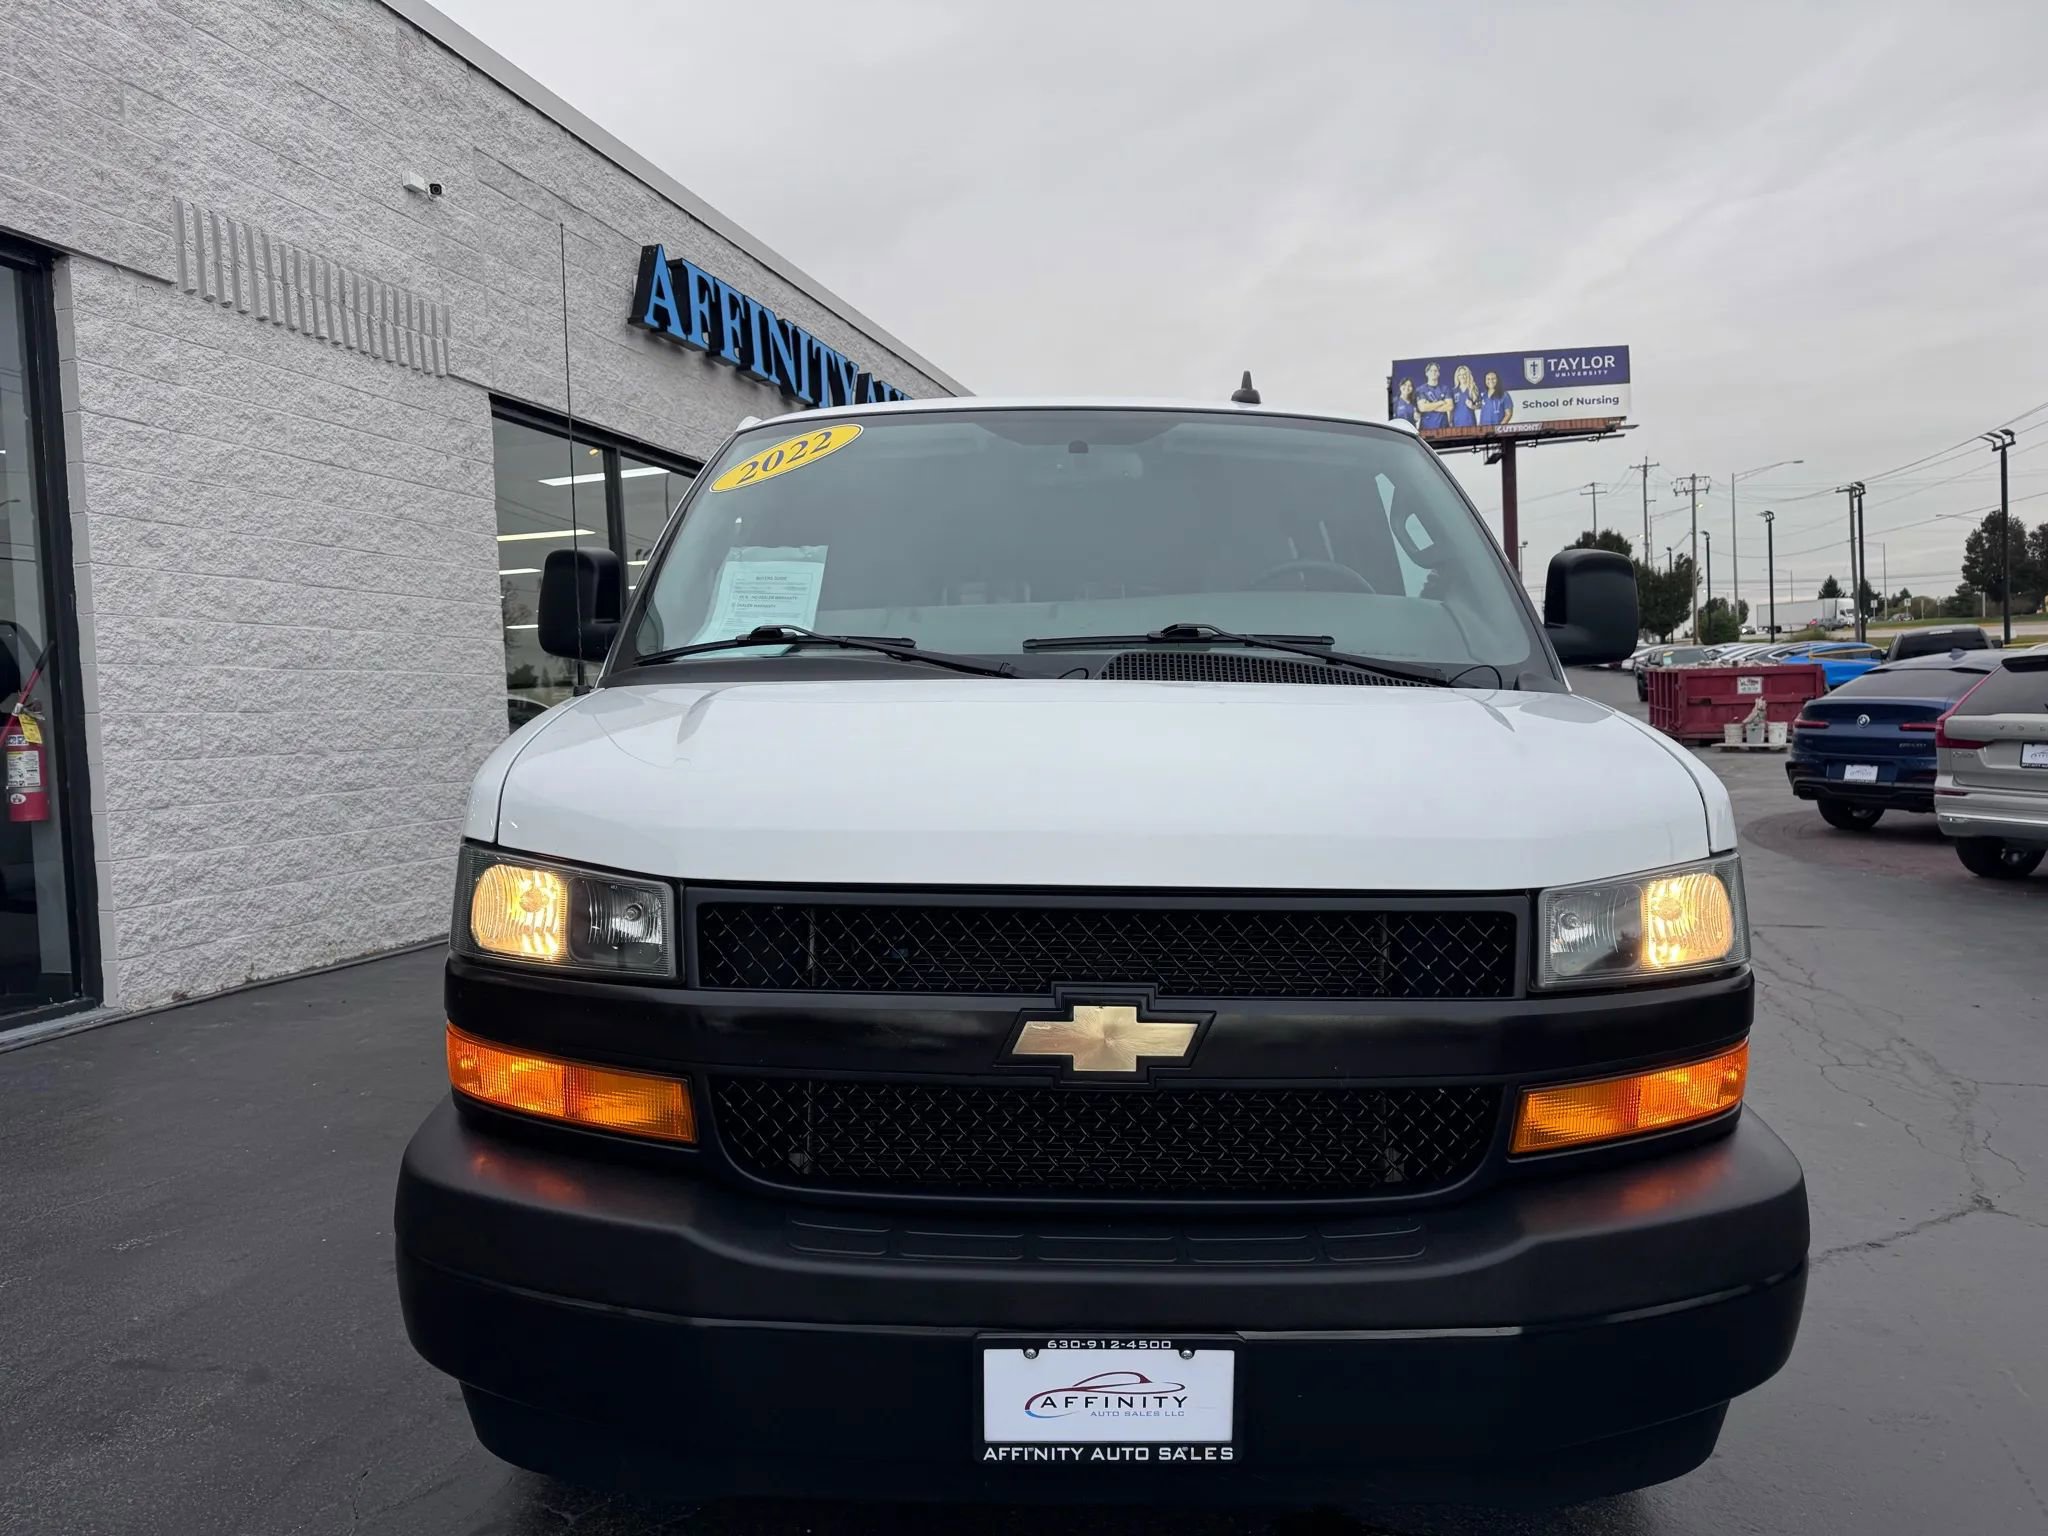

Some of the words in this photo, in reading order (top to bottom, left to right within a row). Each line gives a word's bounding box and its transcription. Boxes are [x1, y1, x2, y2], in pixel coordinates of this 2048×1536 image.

[642, 243, 860, 409] AFFINITY
[1547, 355, 1615, 371] TAYLOR
[1522, 398, 1559, 409] School
[1562, 397, 1573, 407] of
[1576, 395, 1620, 406] Nursing
[735, 431, 832, 486] 2022
[1047, 1340, 1172, 1349] 630-912-4500
[1040, 1396, 1188, 1408] AFFINITY
[983, 1447, 1084, 1461] AFFINITY
[1090, 1447, 1150, 1461] AUTO
[1158, 1447, 1234, 1461] SALES
